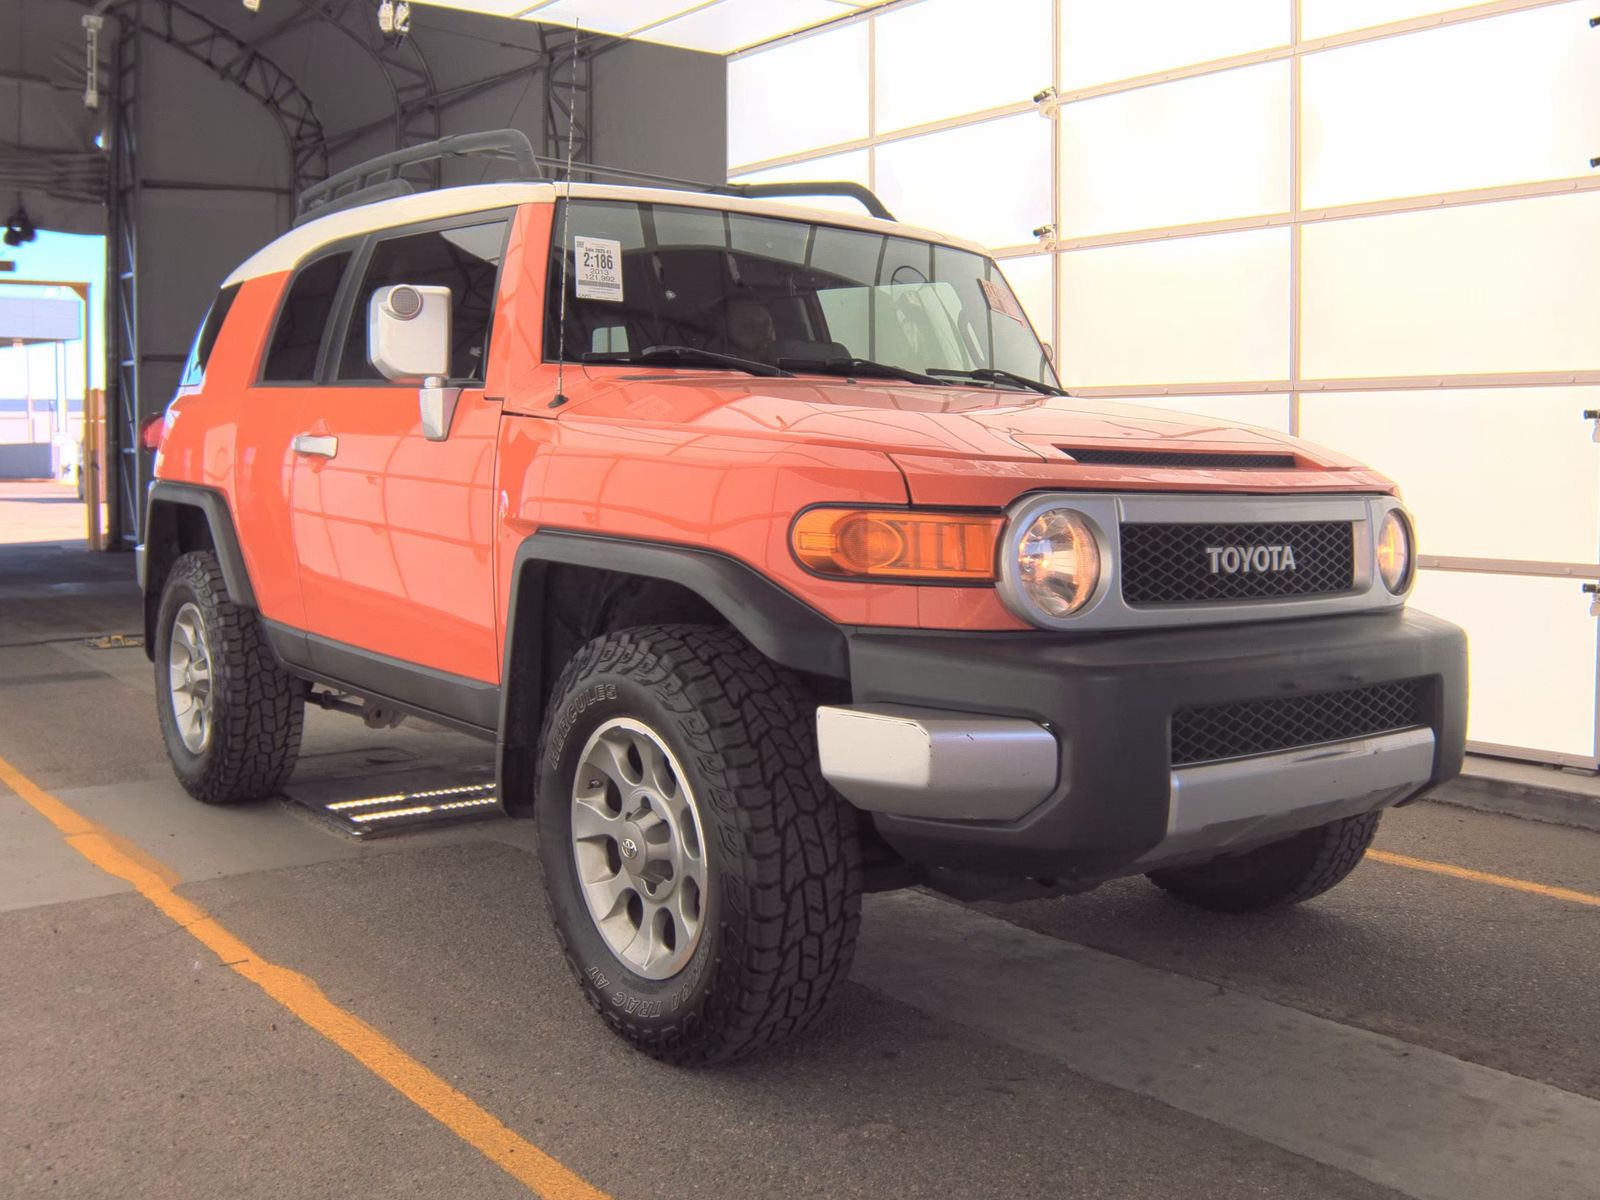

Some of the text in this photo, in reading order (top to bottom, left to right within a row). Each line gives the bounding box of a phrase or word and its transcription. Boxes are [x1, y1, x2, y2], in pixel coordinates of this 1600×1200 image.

[584, 253, 613, 269] 2:186
[1206, 545, 1296, 574] TOYOTA
[547, 683, 618, 770] HERCULES
[611, 991, 662, 1018] TRAC
